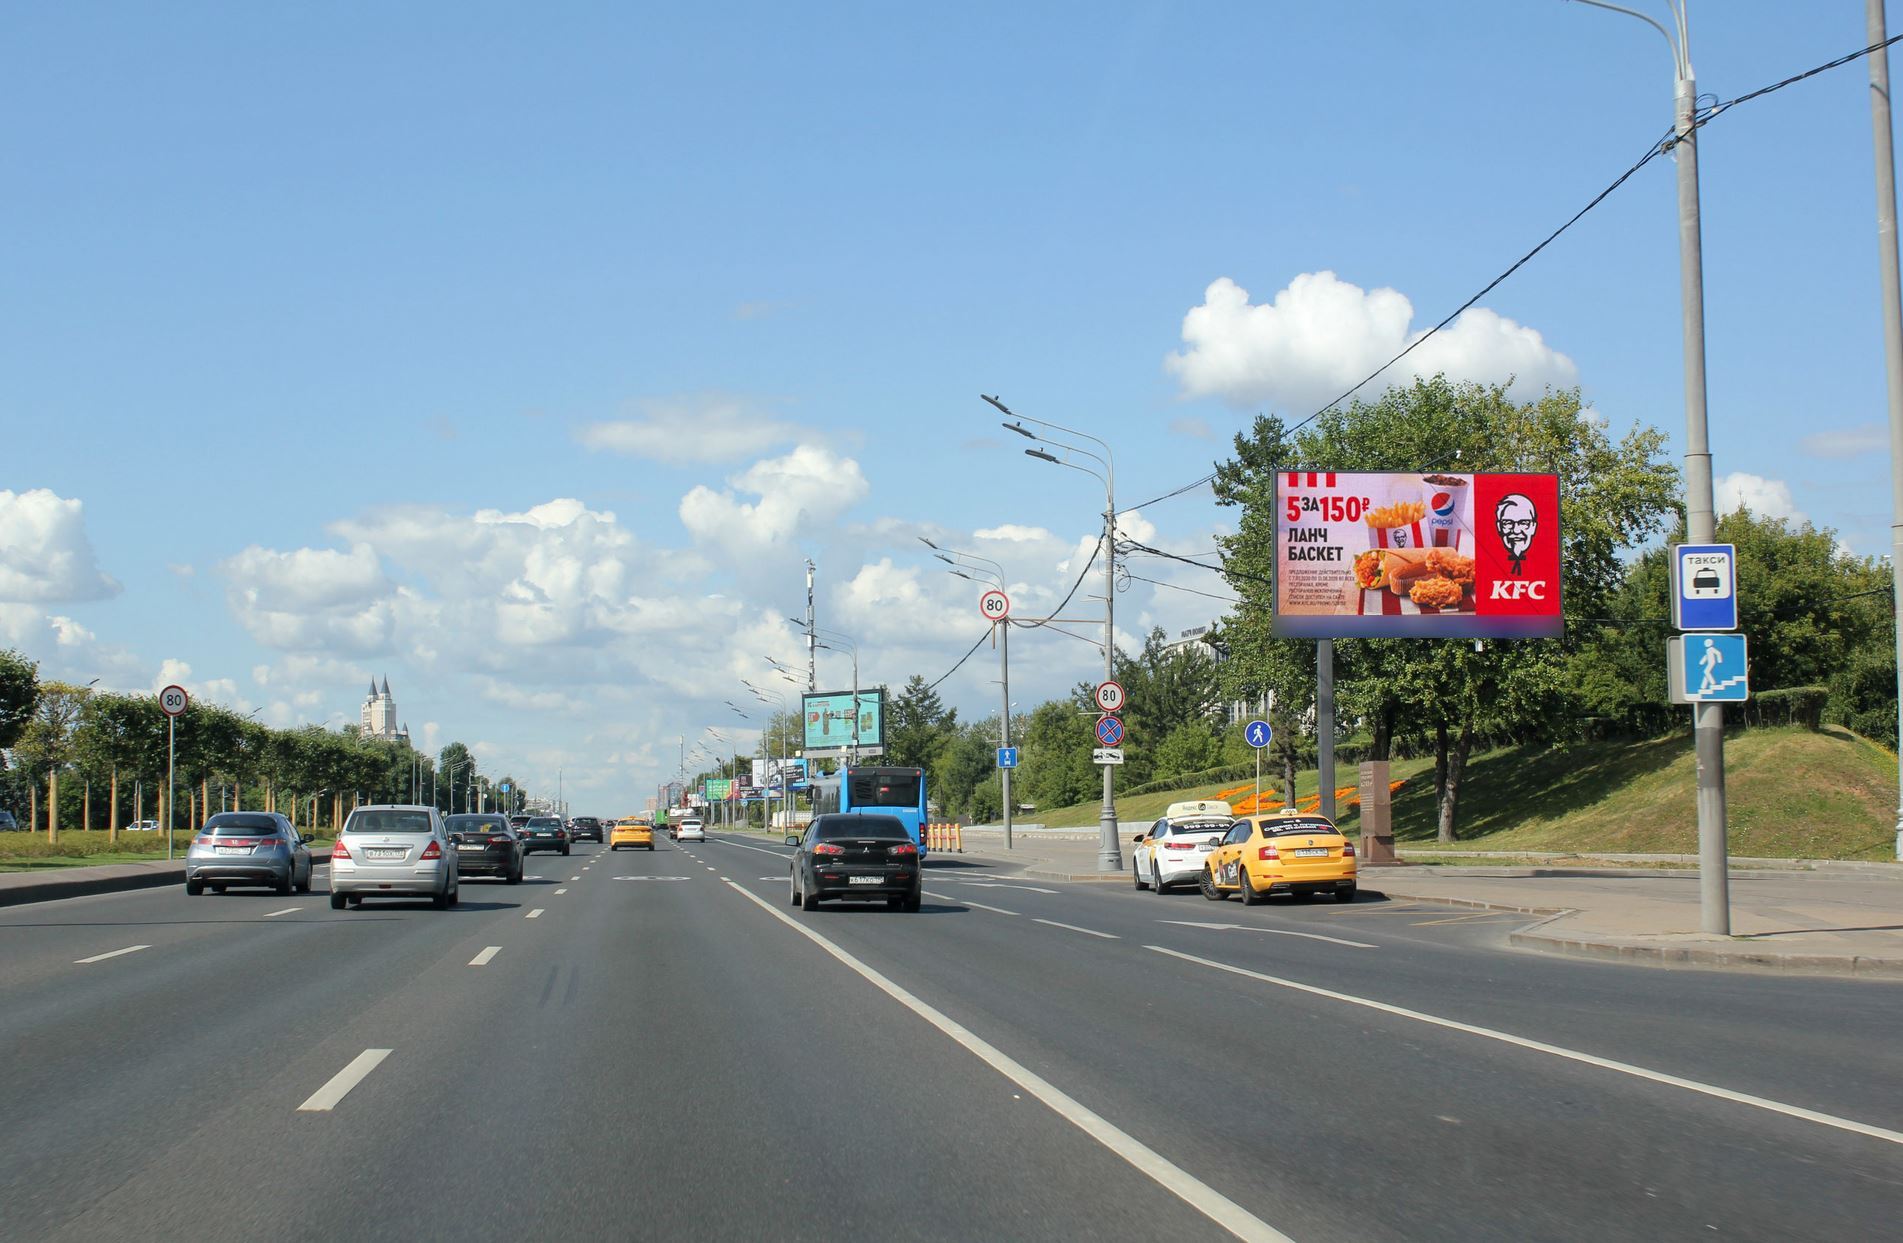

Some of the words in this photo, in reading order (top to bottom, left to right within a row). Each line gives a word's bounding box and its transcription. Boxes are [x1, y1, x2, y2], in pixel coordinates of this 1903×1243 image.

[1288, 527, 1328, 543] ЛАНЧ
[1288, 546, 1343, 561] БАСКЕТ
[1490, 580, 1546, 600] KFC
[986, 598, 1003, 611] 80
[166, 694, 181, 706] 80
[1102, 689, 1116, 701] 80
